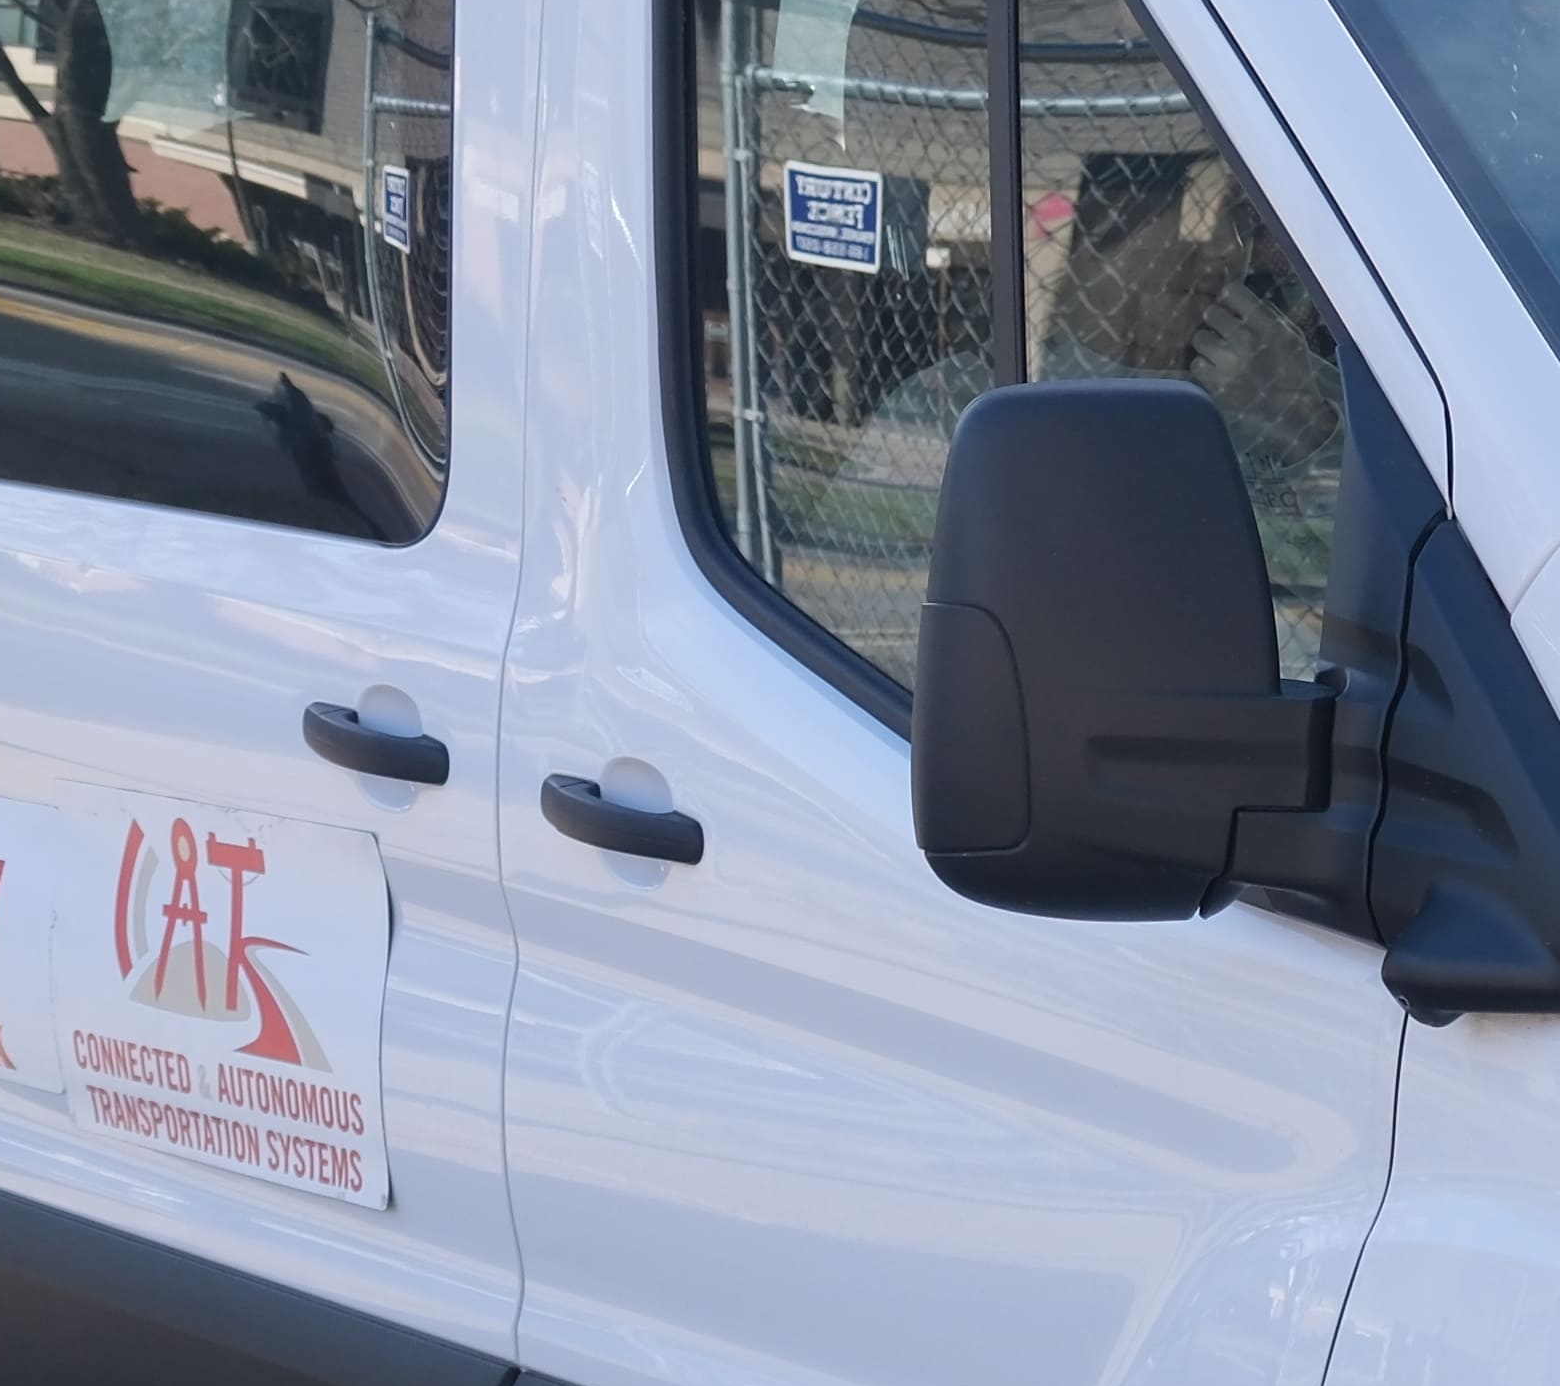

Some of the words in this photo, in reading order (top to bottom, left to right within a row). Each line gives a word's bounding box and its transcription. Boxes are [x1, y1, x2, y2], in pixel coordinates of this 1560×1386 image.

[72, 1029, 191, 1095] CONNECTED
[217, 1063, 365, 1136] AUTONOMOUS
[86, 1084, 260, 1167] TRANSPORTATION
[267, 1129, 362, 1193] SYSTEMS
